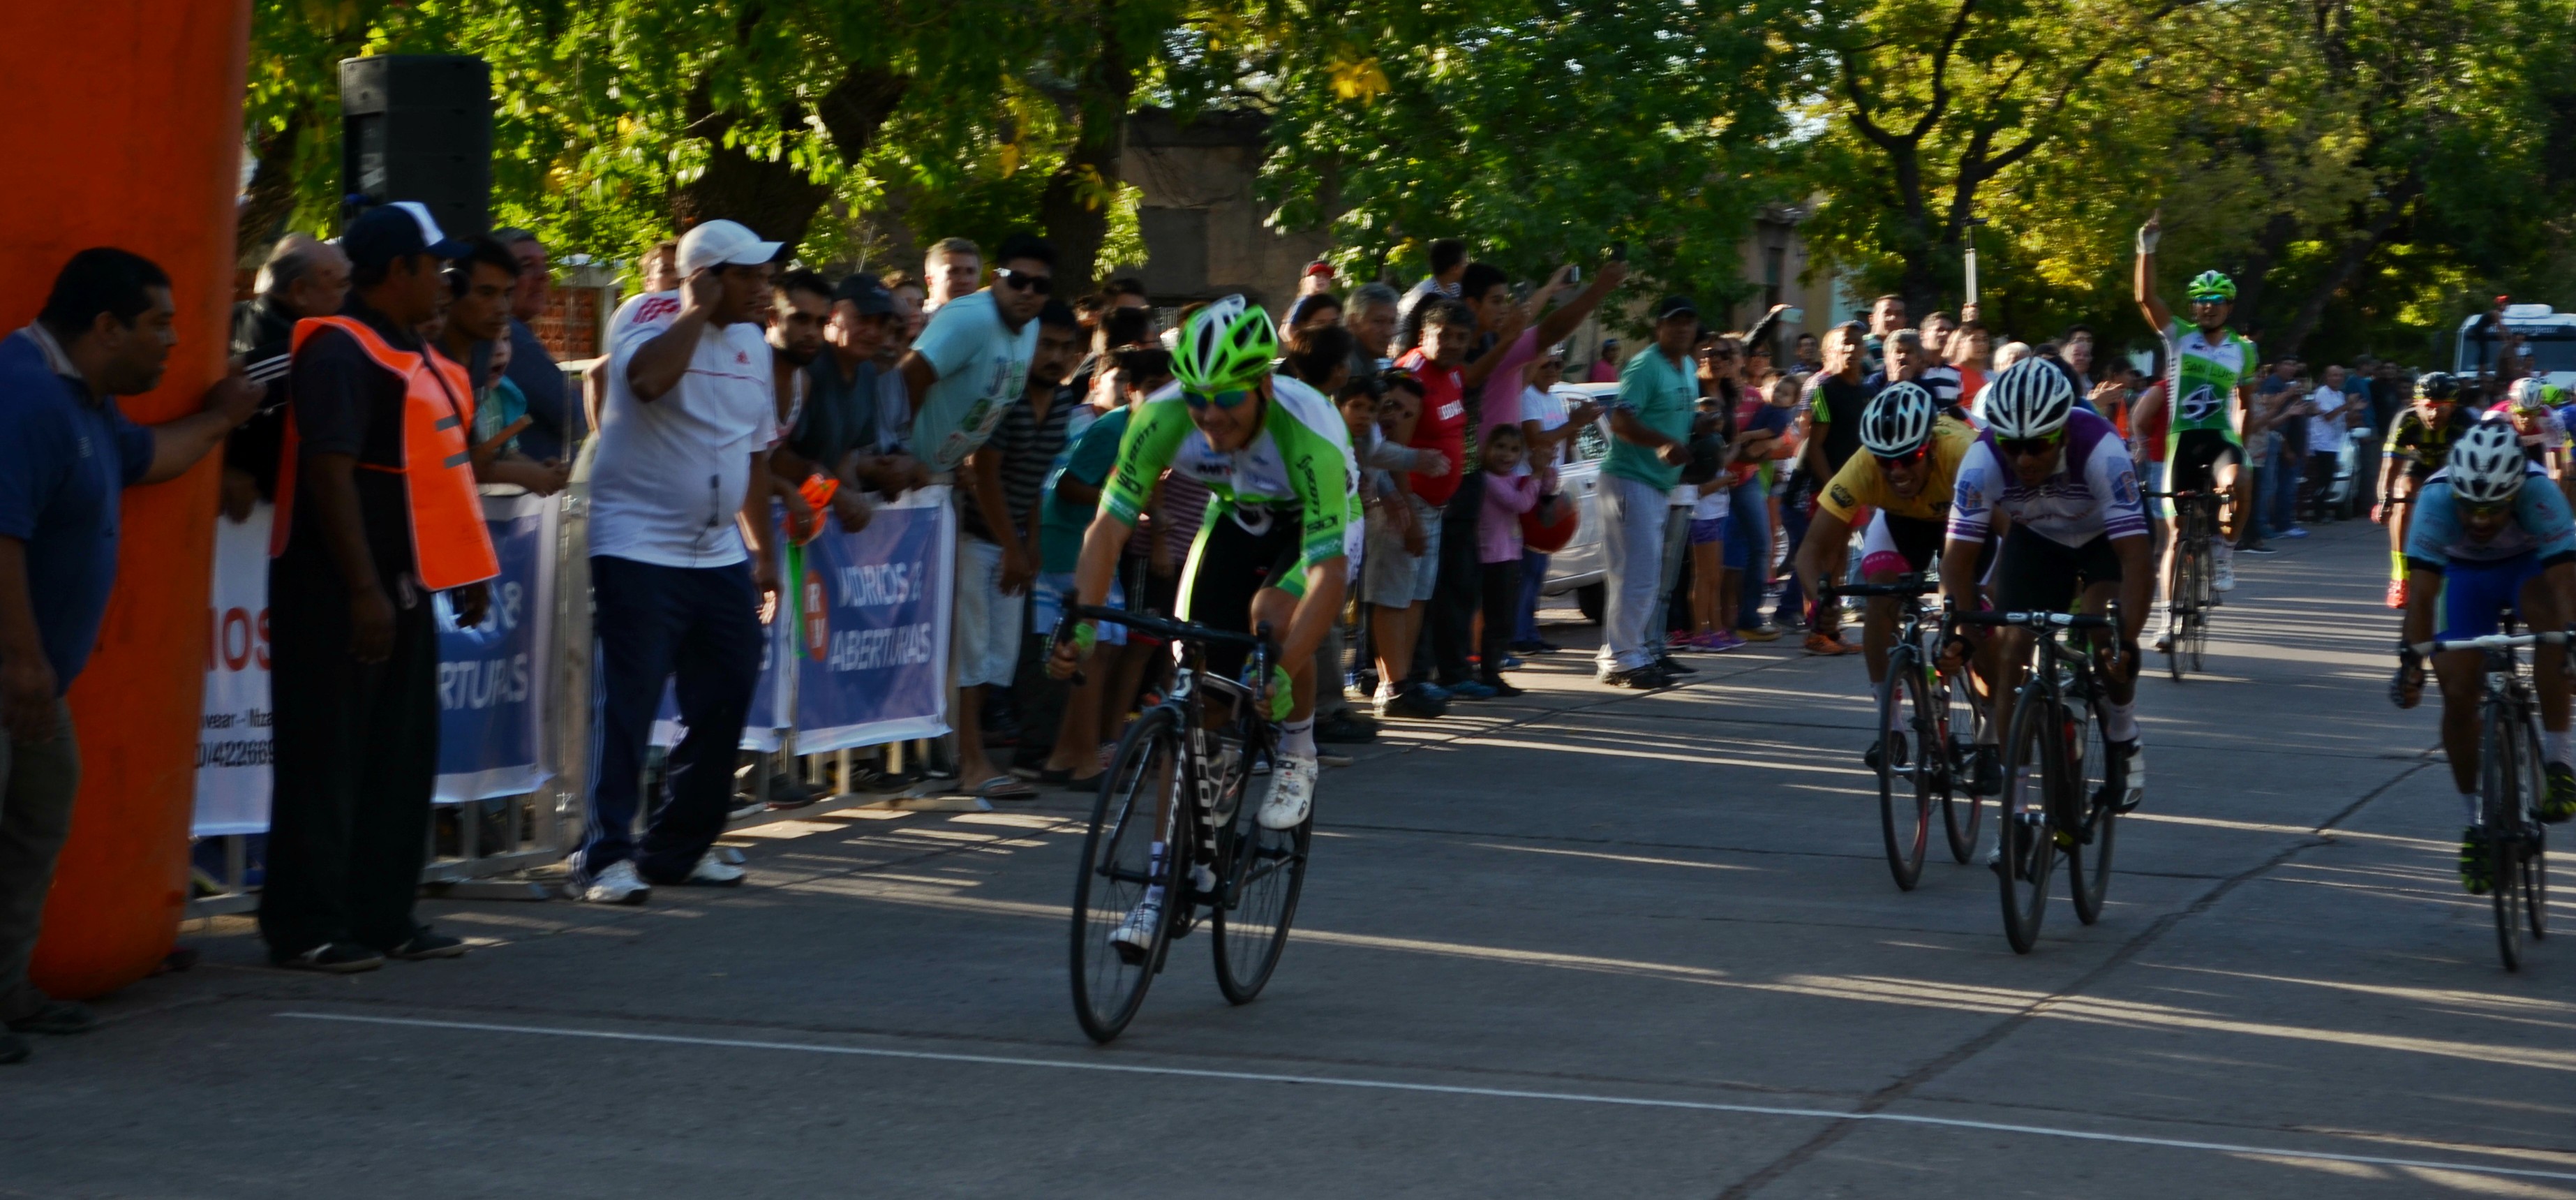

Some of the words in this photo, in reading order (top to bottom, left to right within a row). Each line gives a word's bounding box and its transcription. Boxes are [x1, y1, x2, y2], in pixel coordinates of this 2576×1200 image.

[838, 562, 909, 608] VIDRIOS
[826, 622, 932, 673] ABERTURAS
[1192, 727, 1219, 857] SCOTT
